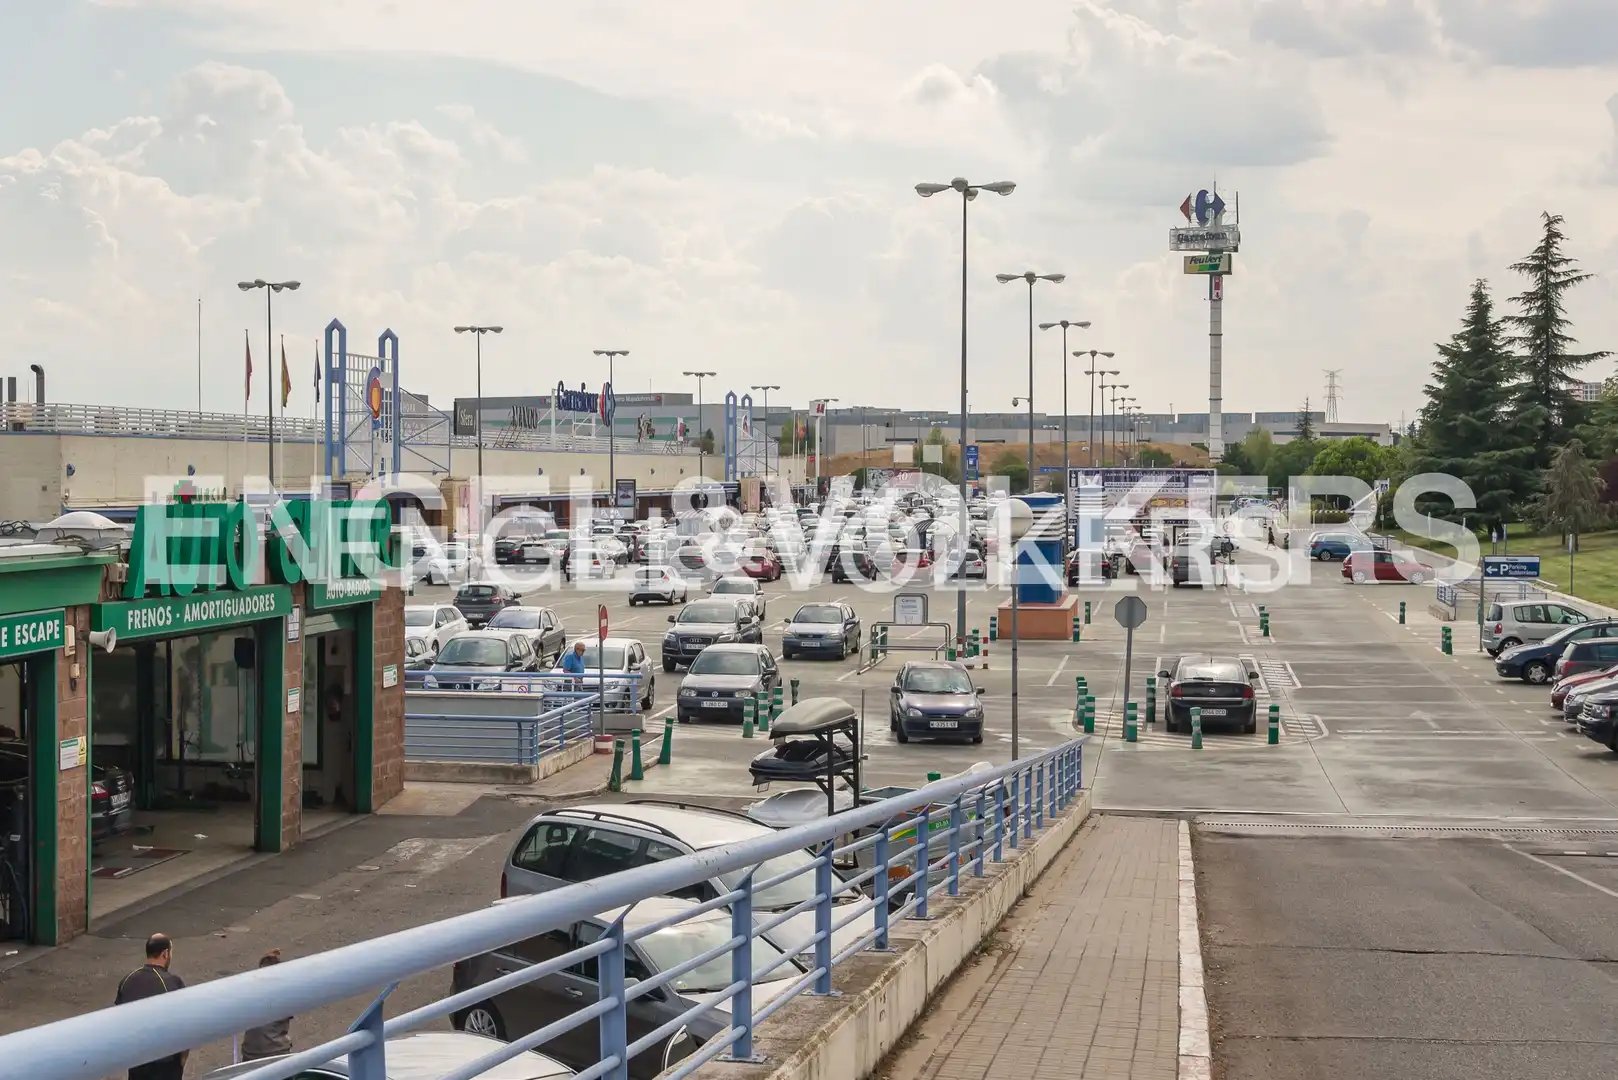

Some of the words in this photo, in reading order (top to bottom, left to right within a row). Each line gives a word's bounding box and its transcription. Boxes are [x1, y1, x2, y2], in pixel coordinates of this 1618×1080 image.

[123, 502, 258, 599] AUTO
[127, 605, 172, 630] FRENOS
[183, 593, 275, 623] AMORTIGUADORES
[15, 619, 60, 646] ESCAPE
